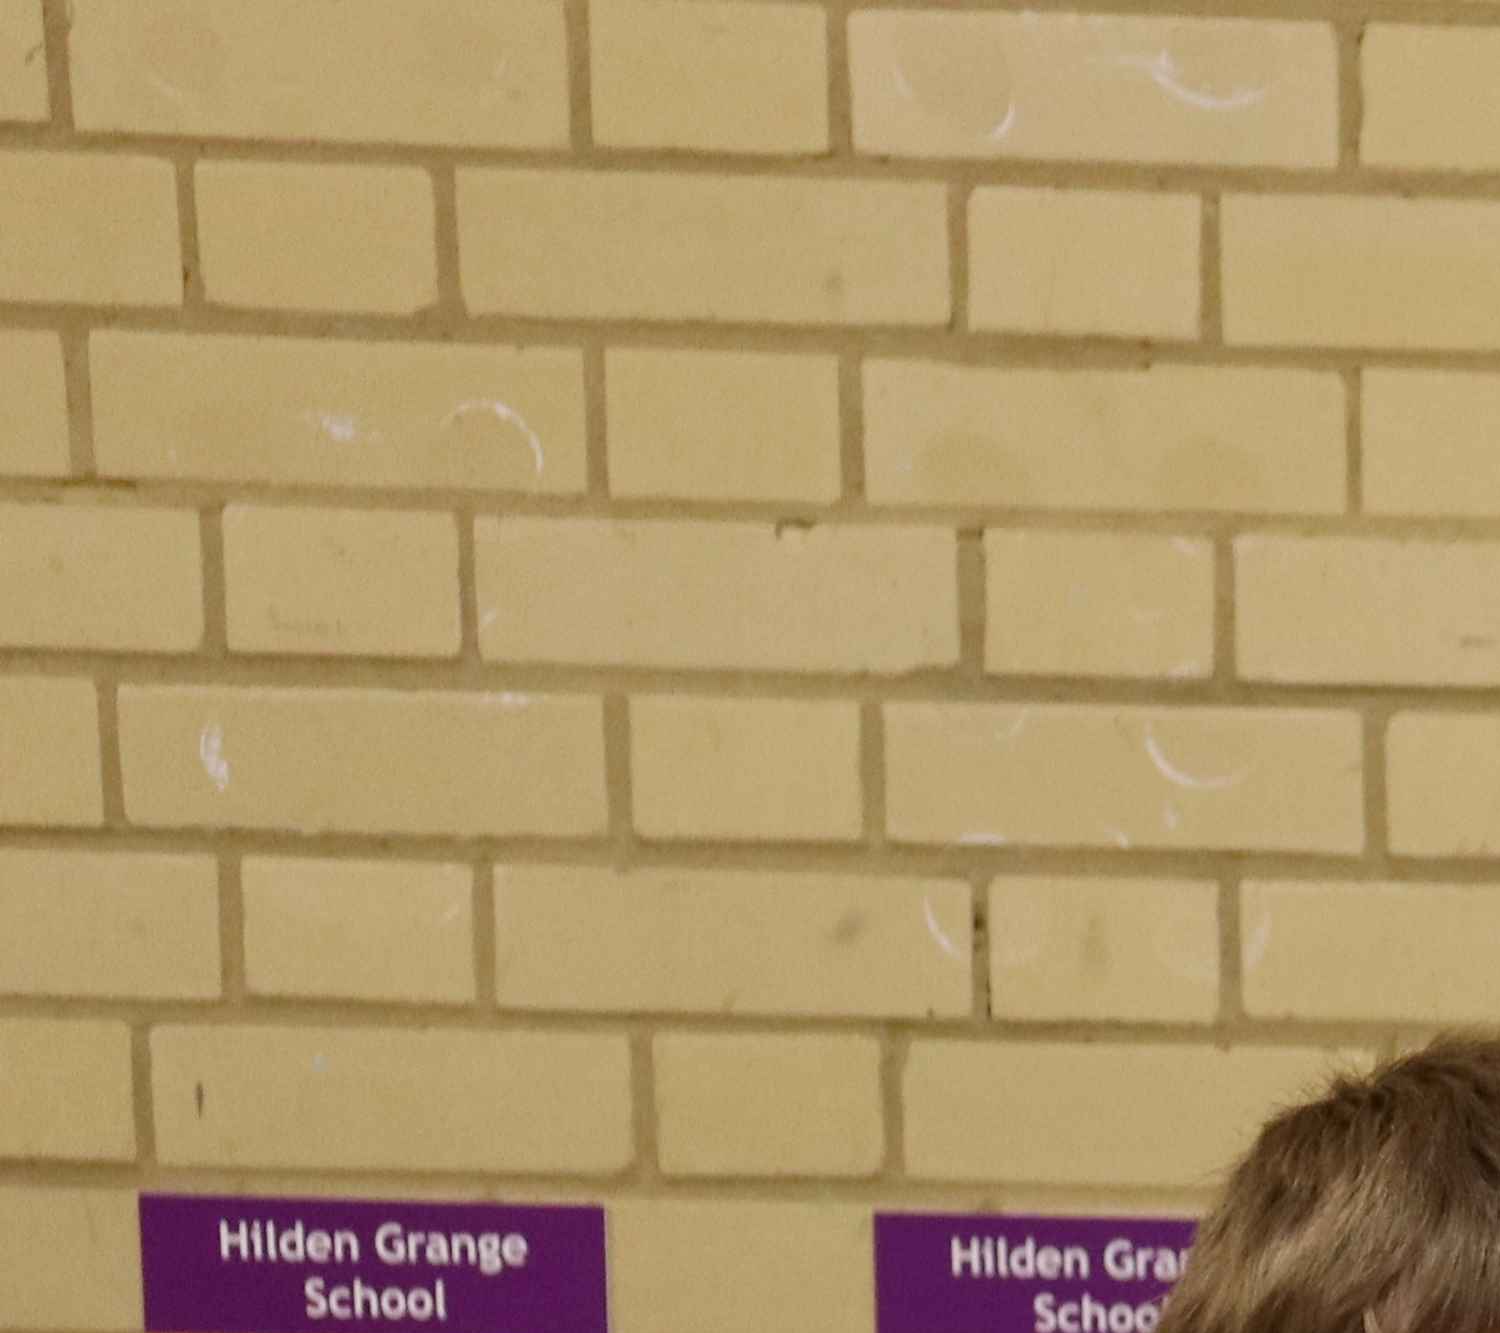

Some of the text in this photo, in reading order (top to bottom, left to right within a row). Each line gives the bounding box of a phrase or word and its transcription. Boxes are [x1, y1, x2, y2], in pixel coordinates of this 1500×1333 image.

[219, 1220, 528, 1273] Hilden Grange
[951, 1236, 1188, 1283] Hilden Gra
[305, 1277, 447, 1321] School
